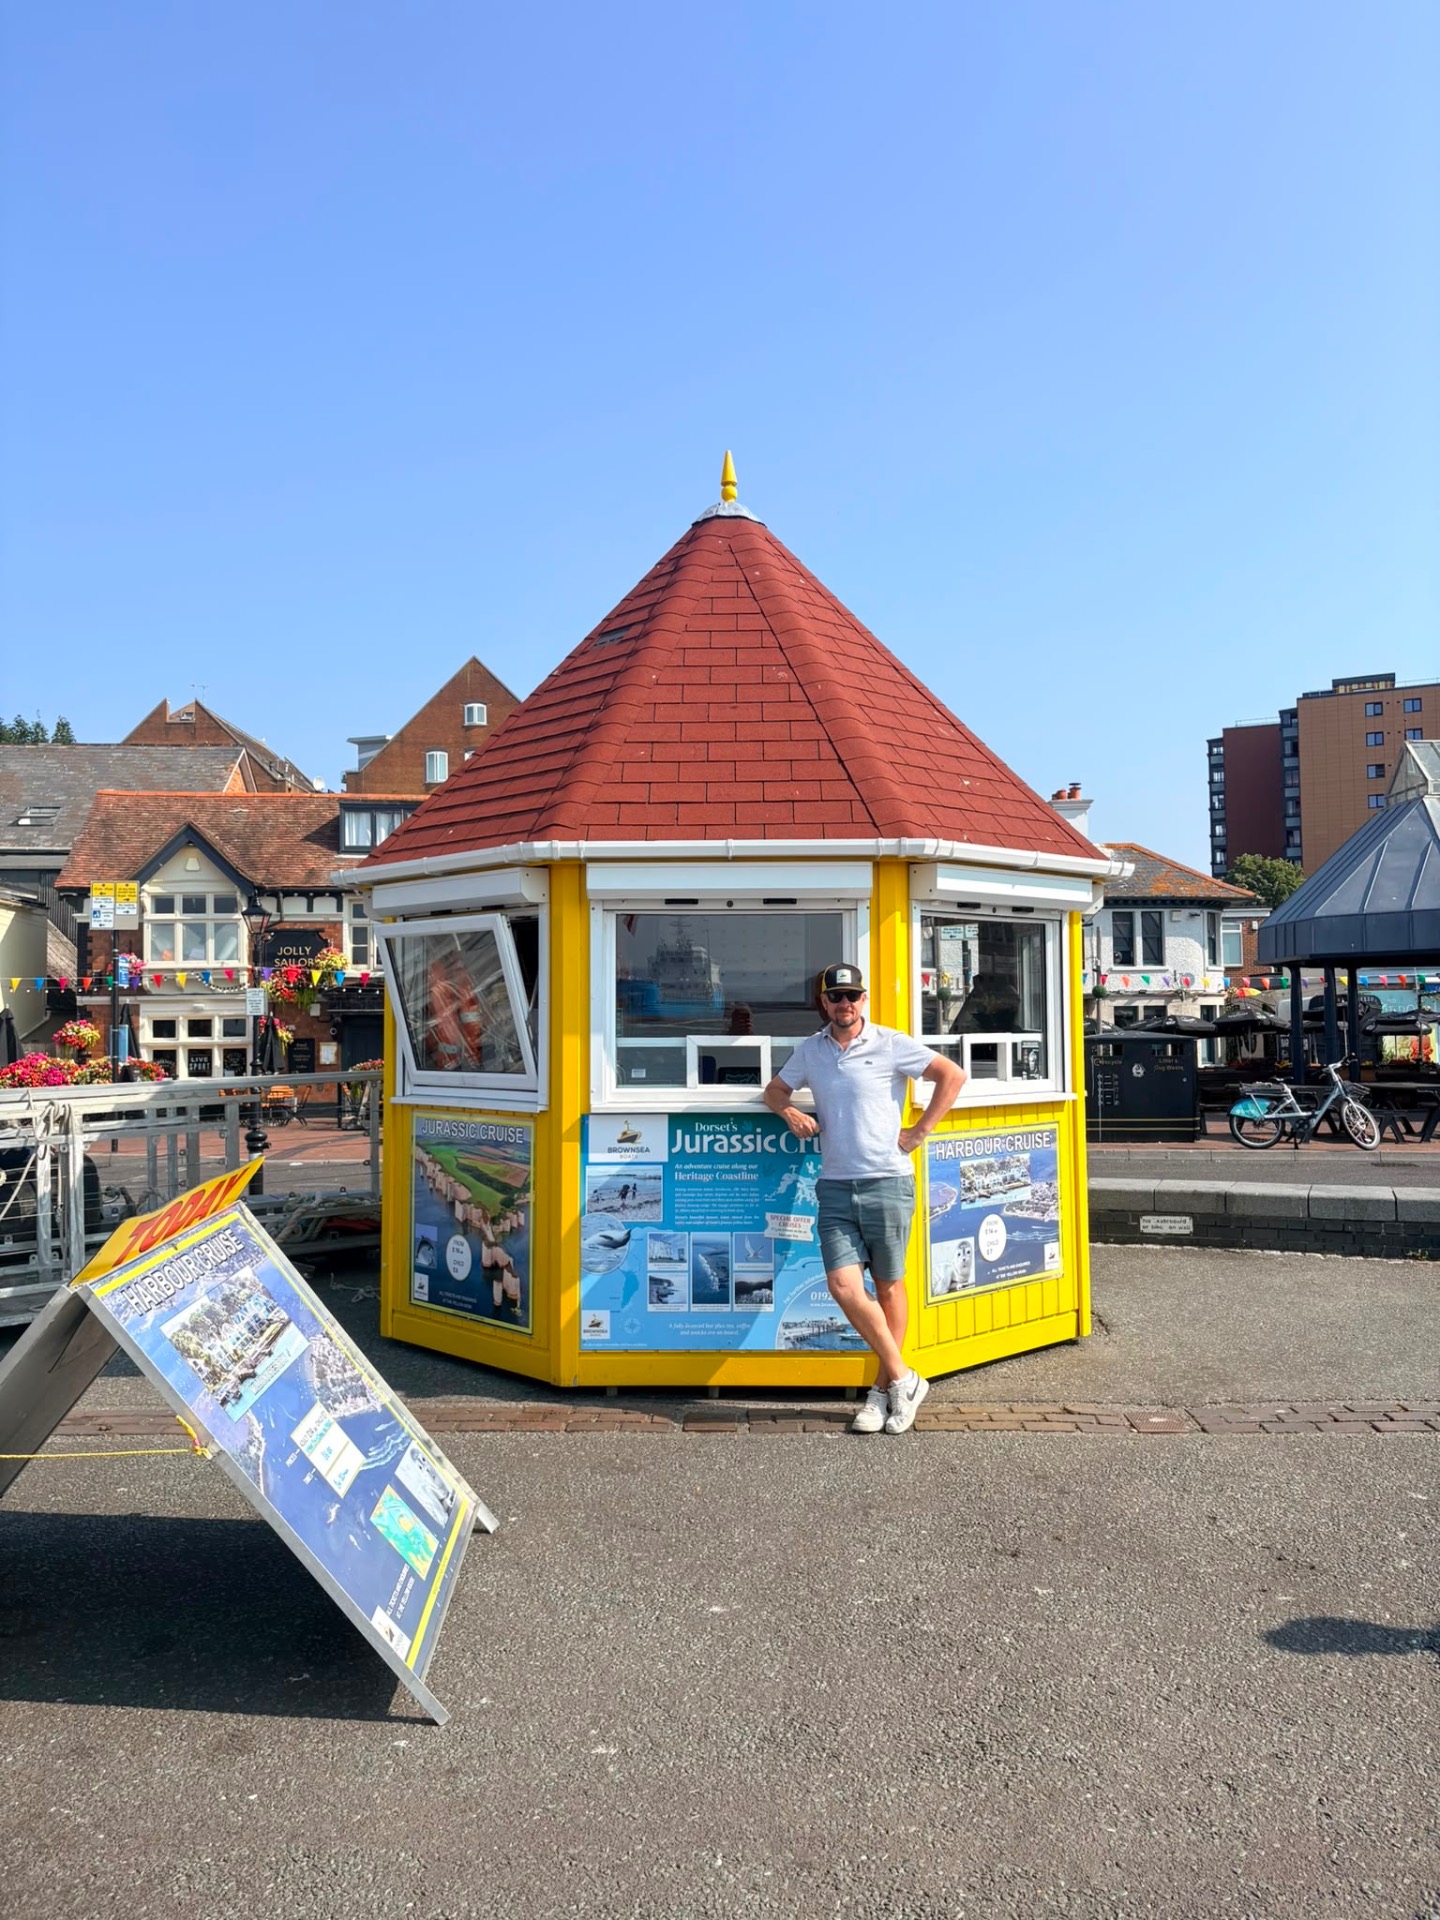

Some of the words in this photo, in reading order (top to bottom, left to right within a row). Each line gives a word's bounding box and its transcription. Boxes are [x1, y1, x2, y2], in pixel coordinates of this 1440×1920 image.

[277, 946, 312, 955] JOLLY
[274, 958, 314, 968] SAILOR
[422, 1119, 476, 1138] JURASSIC
[479, 1124, 524, 1143] CRUISE
[695, 1121, 738, 1132] Dorset's
[671, 1128, 777, 1154] Jurassic
[935, 1137, 1003, 1161] HARBOUR
[1005, 1132, 1051, 1152] CRUISE
[607, 1146, 650, 1154] BROWNSEA
[731, 1162, 747, 1170] along
[675, 1171, 714, 1182] Heritage
[715, 1171, 759, 1181] Coastline
[112, 1167, 250, 1268] TODAY
[770, 1214, 791, 1222] SPECIAL
[120, 1251, 199, 1317] HARBOUR
[193, 1228, 245, 1276] CRUISE
